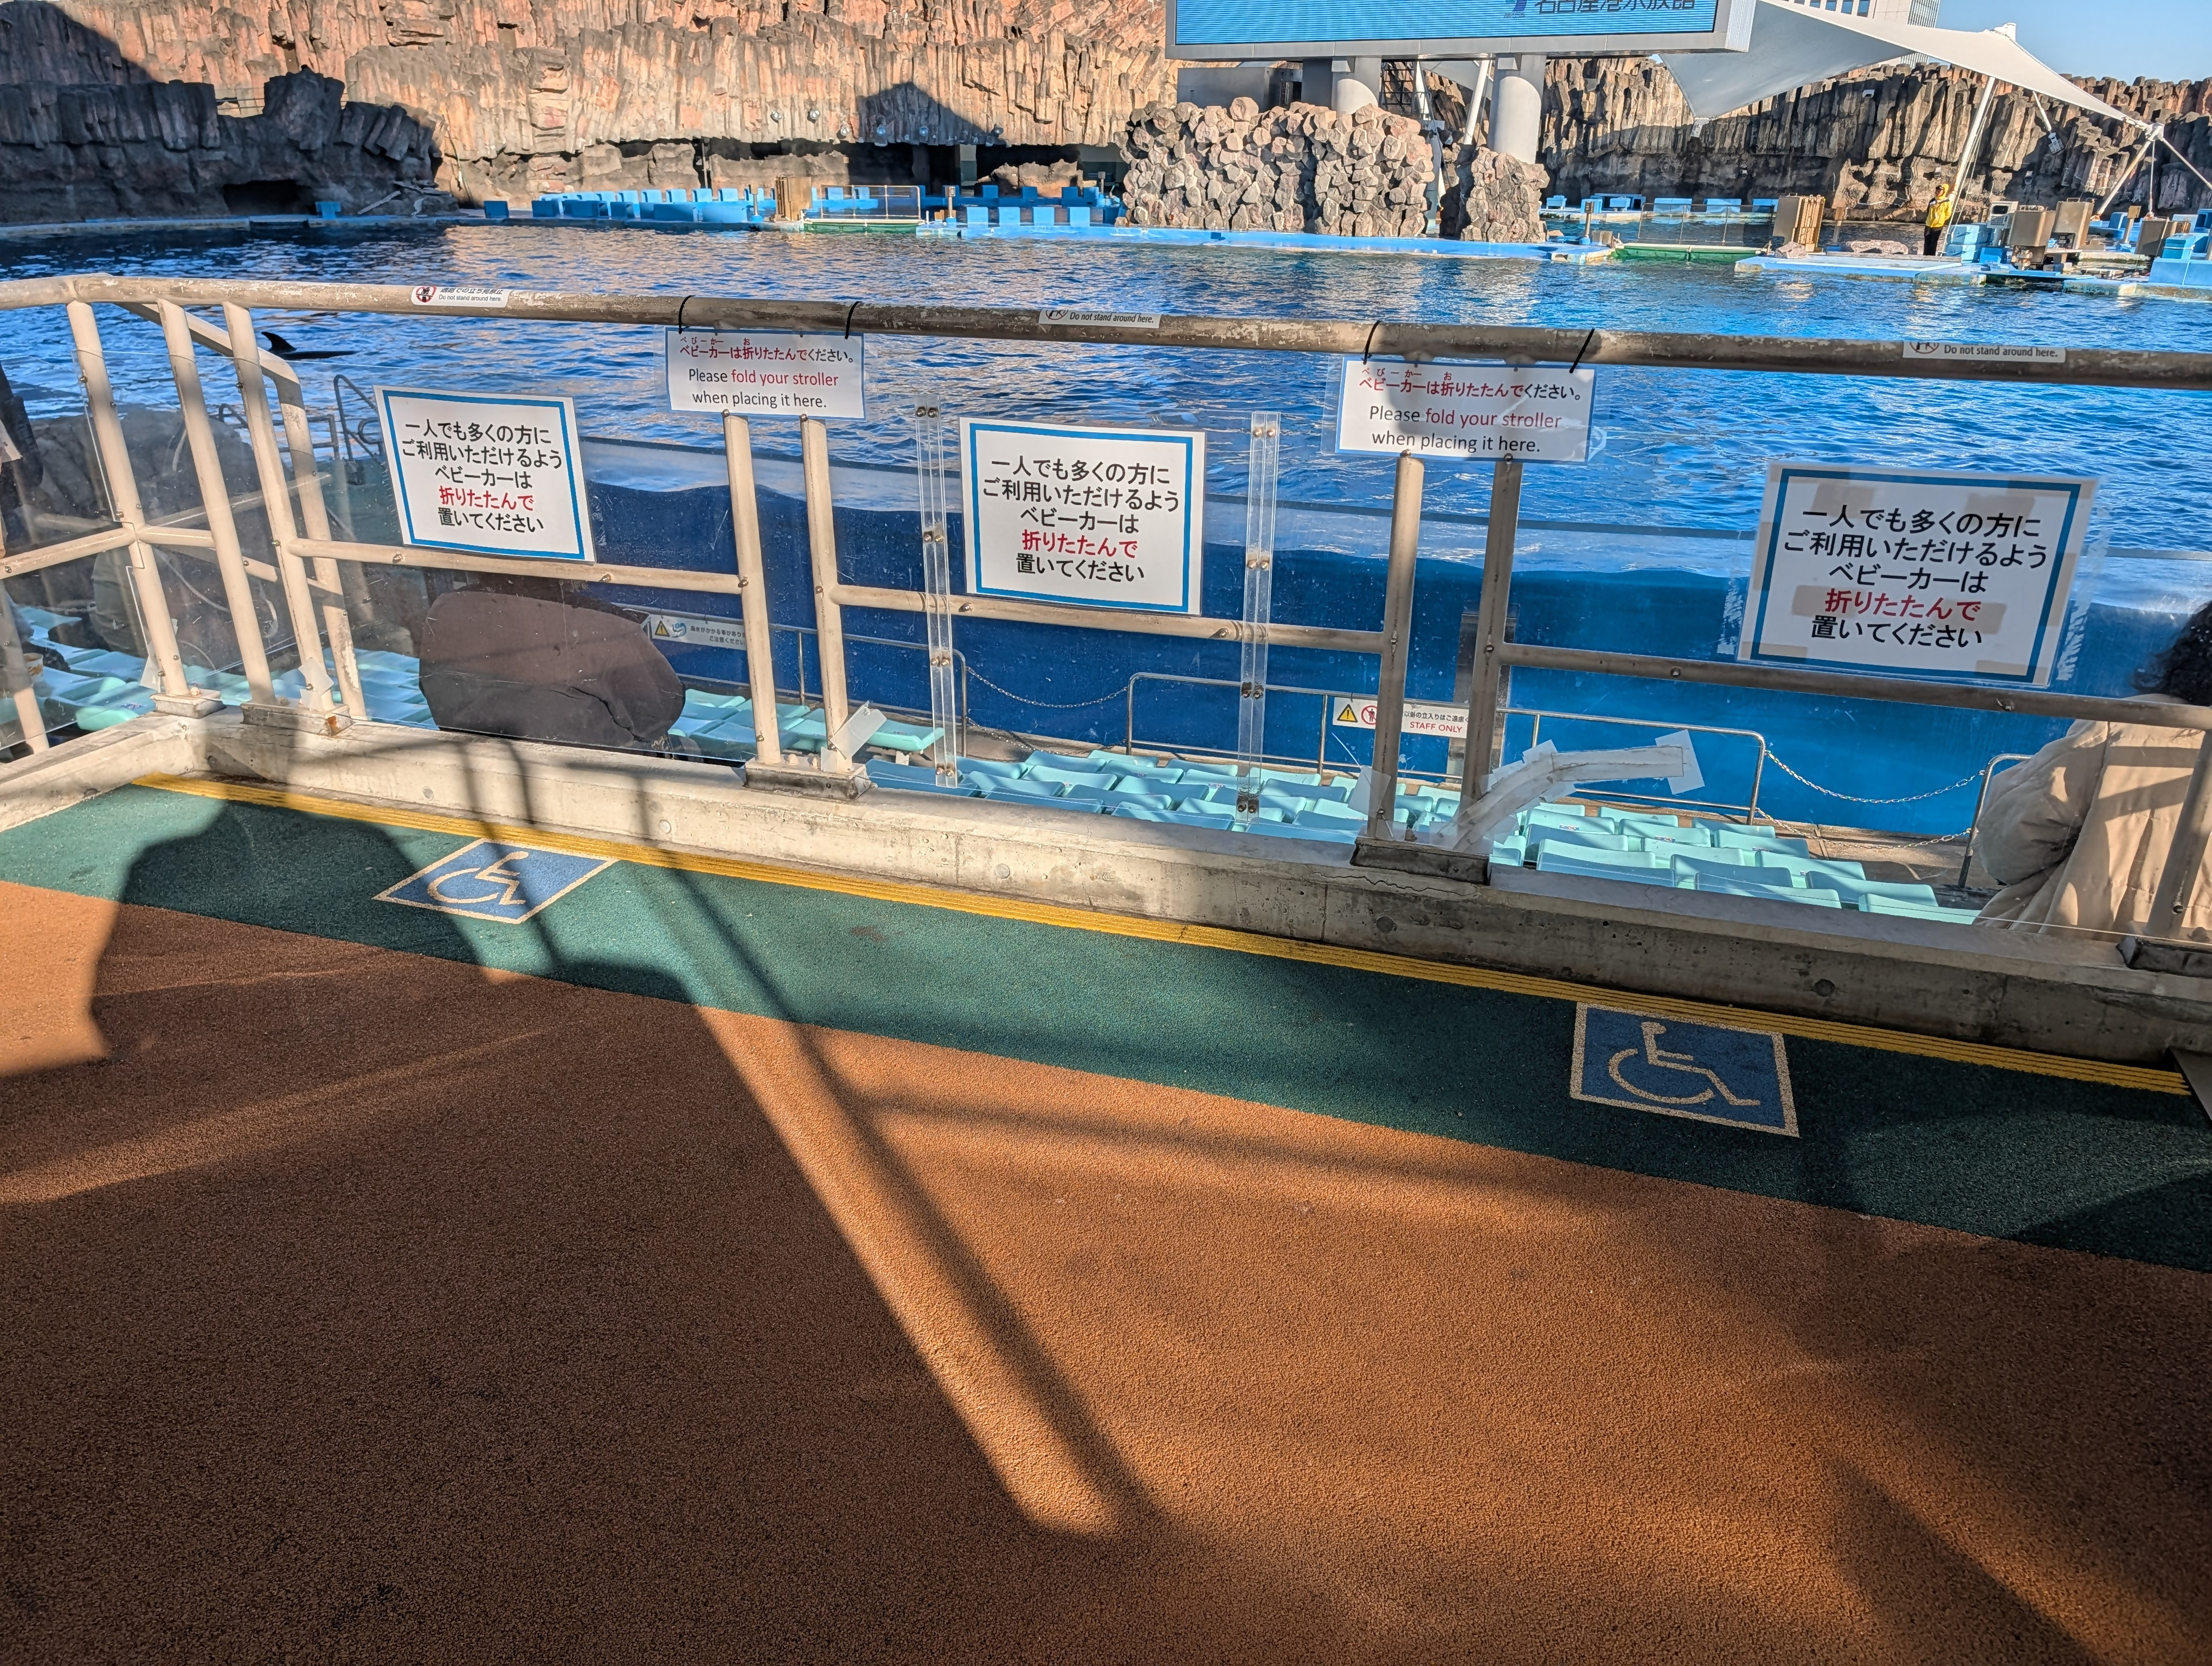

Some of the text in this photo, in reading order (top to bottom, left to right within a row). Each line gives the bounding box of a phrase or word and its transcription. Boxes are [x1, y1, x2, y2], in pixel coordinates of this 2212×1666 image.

[1070, 312, 1079, 321] Do
[1094, 313, 1111, 322] stand
[1113, 313, 1136, 323] around
[1137, 313, 1154, 323] here.
[680, 345, 853, 363] ベビーカーは折りたたんでください。
[1944, 344, 1957, 354] Do
[1959, 346, 1973, 355] not
[1977, 346, 1999, 356] stand
[2003, 348, 2033, 356] around
[2036, 348, 2058, 357] here.
[689, 369, 838, 386] Please fold your stroller
[1359, 377, 1580, 400] ベビーカーは折りたたんでください。
[692, 391, 826, 408] when placing it here.
[1370, 406, 1561, 428] Please fold your stroller
[406, 419, 551, 445] 一人でも多くの方に
[1372, 430, 1540, 453] when placing it here.
[402, 439, 562, 469] ご利用いただけるよう
[435, 466, 533, 489] ベビーカーは
[992, 456, 1170, 485] 一人でも多くの方に
[439, 485, 534, 511] 折りたたんで
[983, 477, 1179, 512] ご利用いただけるよう
[438, 507, 544, 533] 置いてください
[1020, 507, 1139, 534] ベビーカーは
[1803, 504, 2041, 538] 一人でも多くの方に
[1021, 529, 1137, 558] 折りたたんで
[1784, 531, 2046, 568] ご利用いただけるよう
[1016, 553, 1144, 582] 置いてください
[1829, 564, 1988, 593] ベビーカーは
[1825, 588, 1981, 621] 折りたたんで
[1811, 615, 1982, 648] 置いてください
[1410, 721, 1462, 733] STAFF ONLY
